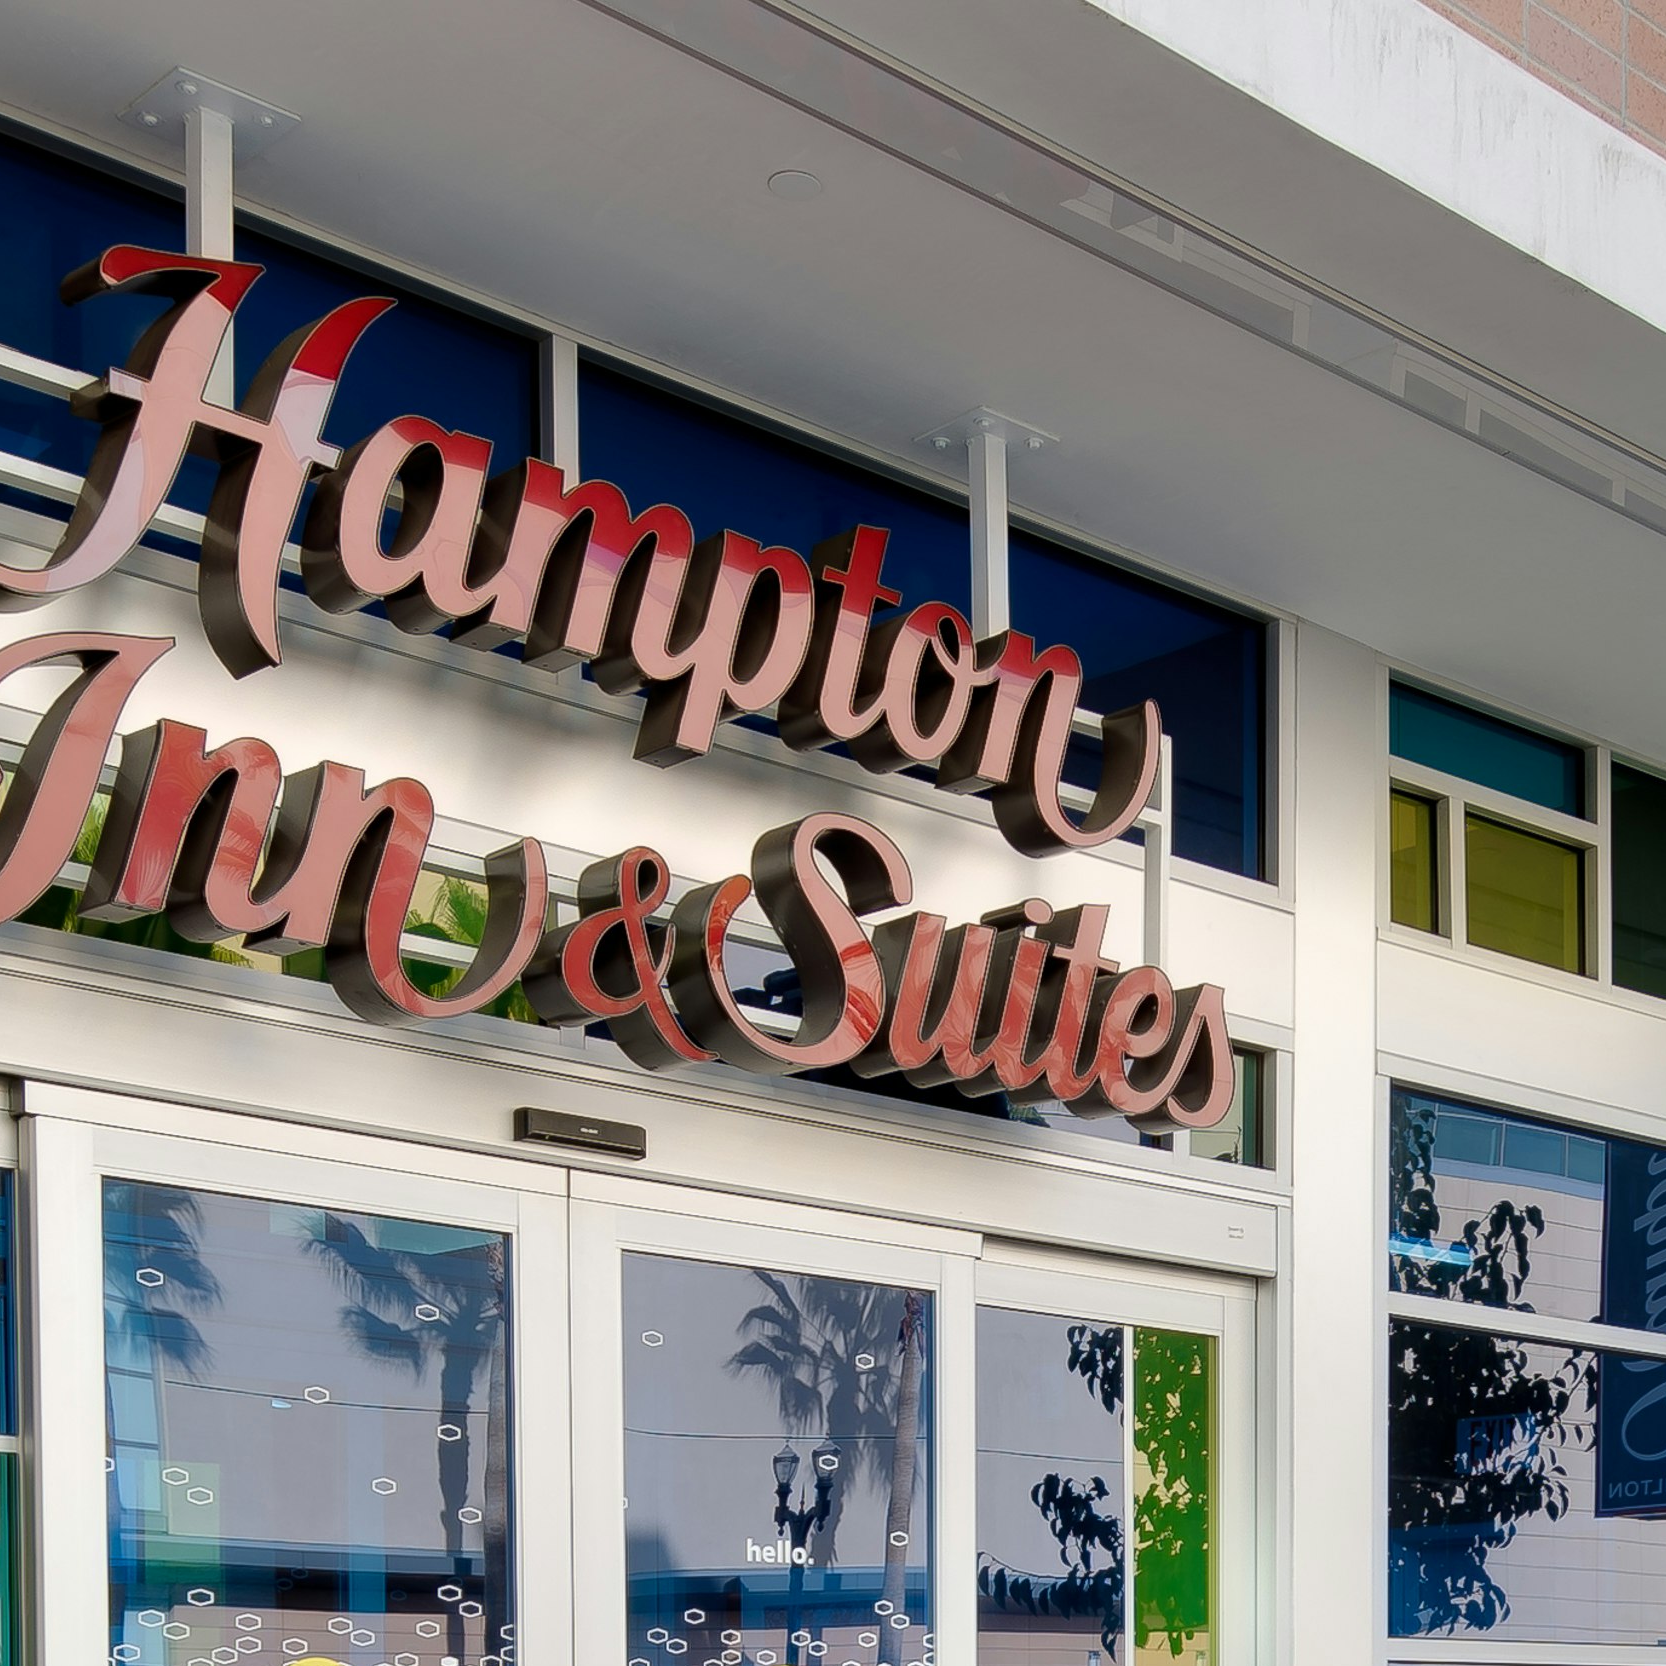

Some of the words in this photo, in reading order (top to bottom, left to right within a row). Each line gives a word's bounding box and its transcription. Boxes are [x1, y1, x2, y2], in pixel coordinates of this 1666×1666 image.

[527, 846, 718, 1073] &
[669, 811, 1236, 1134] Suites
[745, 1537, 815, 1565] hello.
